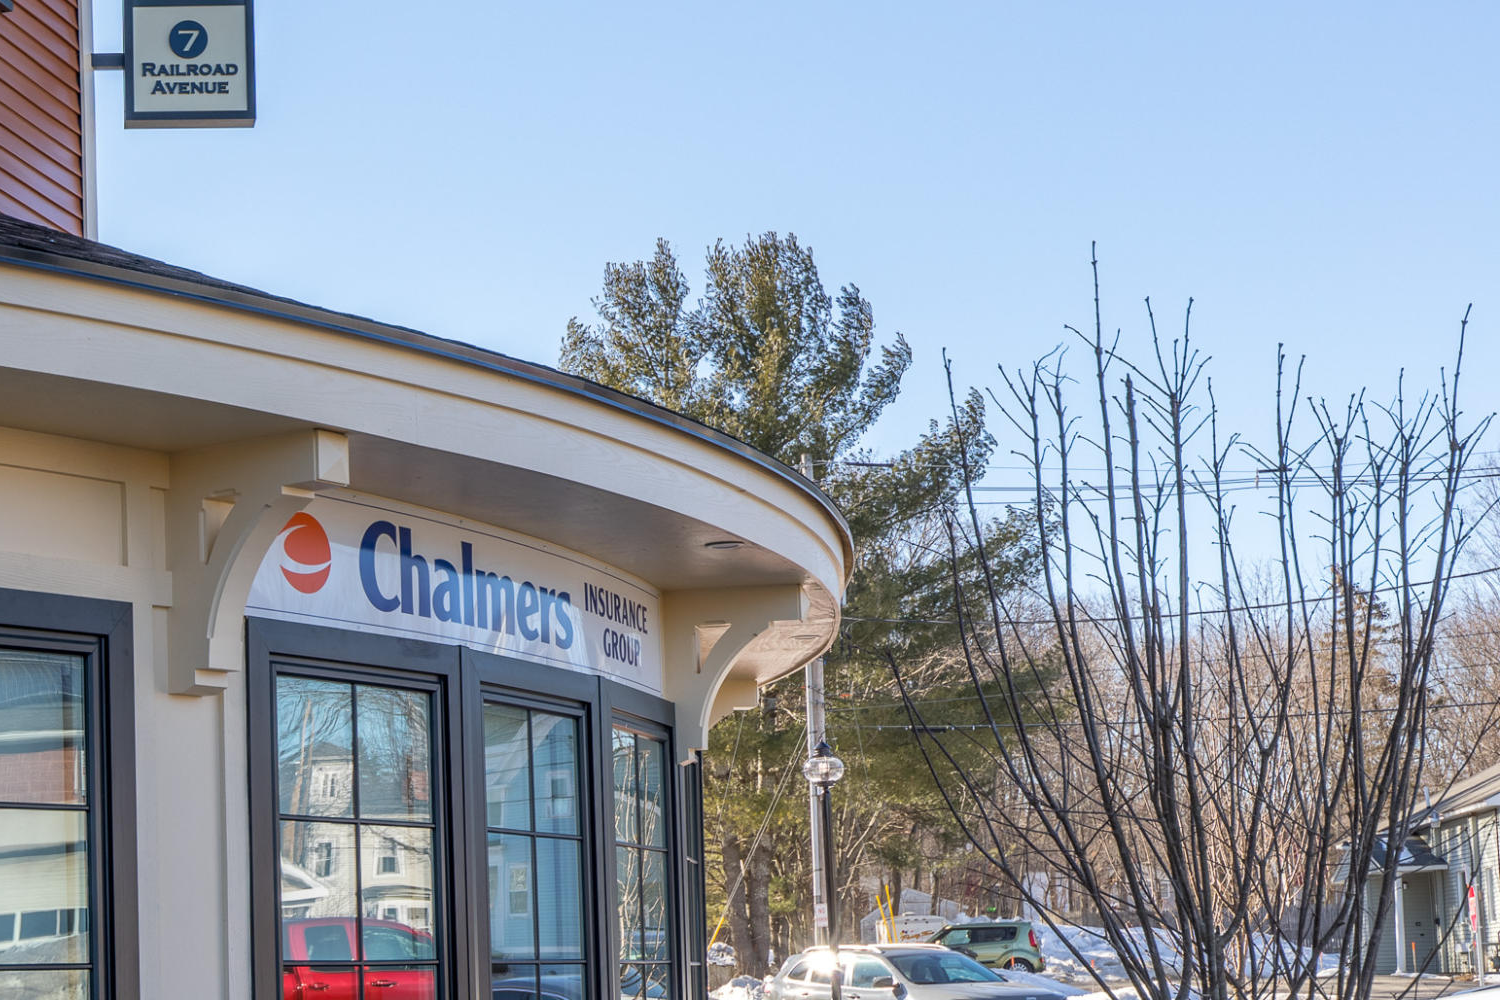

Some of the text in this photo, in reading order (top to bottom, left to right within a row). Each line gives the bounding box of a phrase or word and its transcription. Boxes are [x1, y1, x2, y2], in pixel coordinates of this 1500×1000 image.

[178, 30, 199, 51] 7
[359, 520, 575, 650] Chalmers
[584, 582, 648, 634] INSURANCE
[603, 627, 641, 667] GROUP
